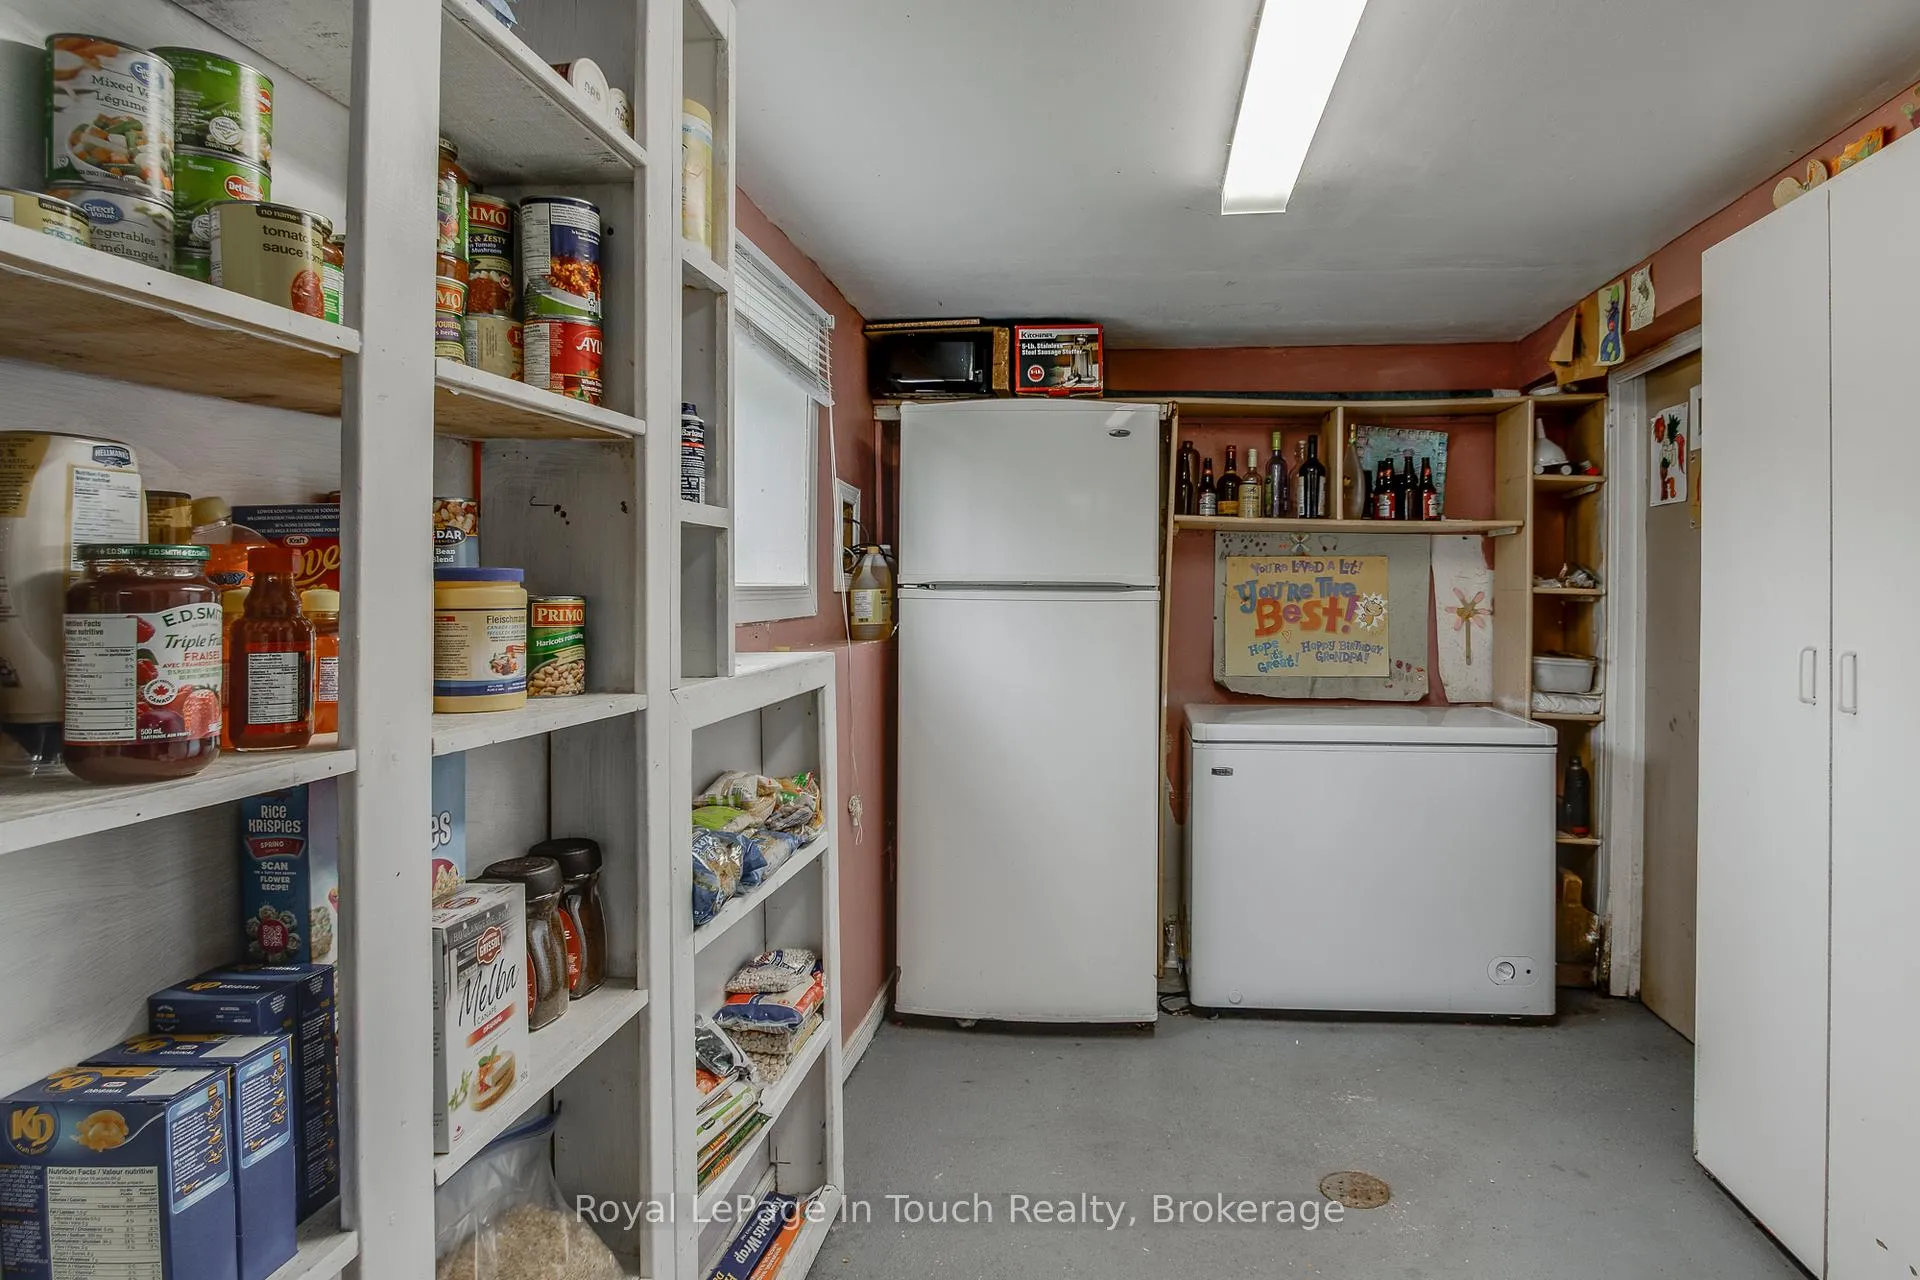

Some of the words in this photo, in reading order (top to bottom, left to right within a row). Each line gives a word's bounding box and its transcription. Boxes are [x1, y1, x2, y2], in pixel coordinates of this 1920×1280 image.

[91, 75, 133, 93] Mixed
[95, 91, 149, 113] Légume
[83, 202, 115, 215] Great
[91, 211, 116, 220] Value
[276, 211, 298, 221] name
[469, 207, 506, 226] IMO
[263, 224, 308, 243] tomato
[484, 233, 506, 244] ZESTY
[100, 243, 159, 261] mélangés
[263, 242, 303, 258] sauce
[576, 337, 602, 355] AYL
[435, 530, 462, 540] DAR
[1327, 560, 1335, 571] A
[537, 607, 583, 622] PRIMO
[165, 634, 206, 652] Triple
[536, 637, 564, 648] Haricots
[148, 694, 175, 704] CANADA
[260, 840, 285, 849] SPRING
[261, 861, 288, 870] SCAN
[458, 959, 516, 1027] Melba
[12, 1106, 55, 1147] KD
[734, 1234, 763, 1264] Wrap
